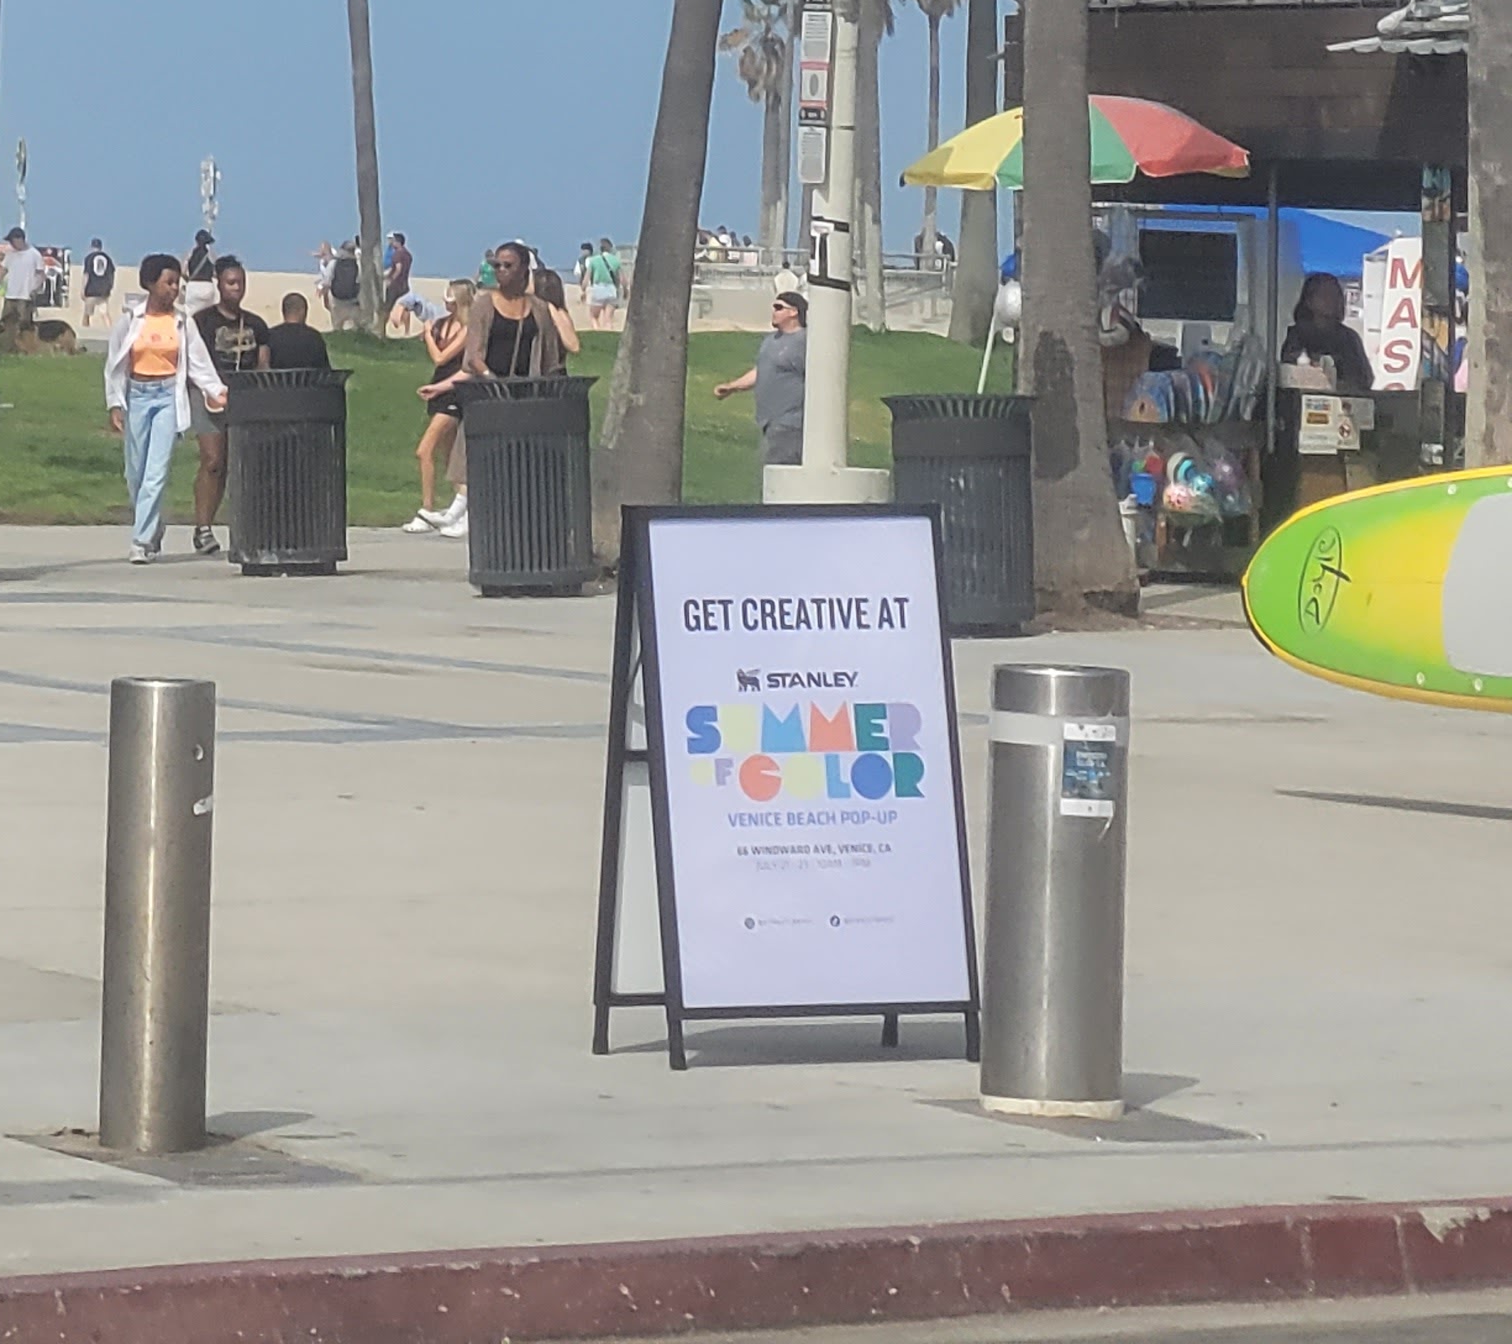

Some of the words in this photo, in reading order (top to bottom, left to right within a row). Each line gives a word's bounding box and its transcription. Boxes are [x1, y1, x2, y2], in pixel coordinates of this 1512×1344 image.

[1383, 257, 1424, 391] MAS
[684, 599, 734, 632] GET
[741, 597, 871, 631] CREATIVE
[877, 597, 909, 630] AT
[766, 671, 859, 689] STANLEY
[685, 700, 923, 754] SUMMER
[690, 757, 735, 787] OF
[739, 752, 925, 802] COLOR
[728, 811, 783, 827] VENICE
[787, 811, 836, 826] BEACH
[840, 809, 898, 825] POP-UP
[878, 843, 892, 853] CA
